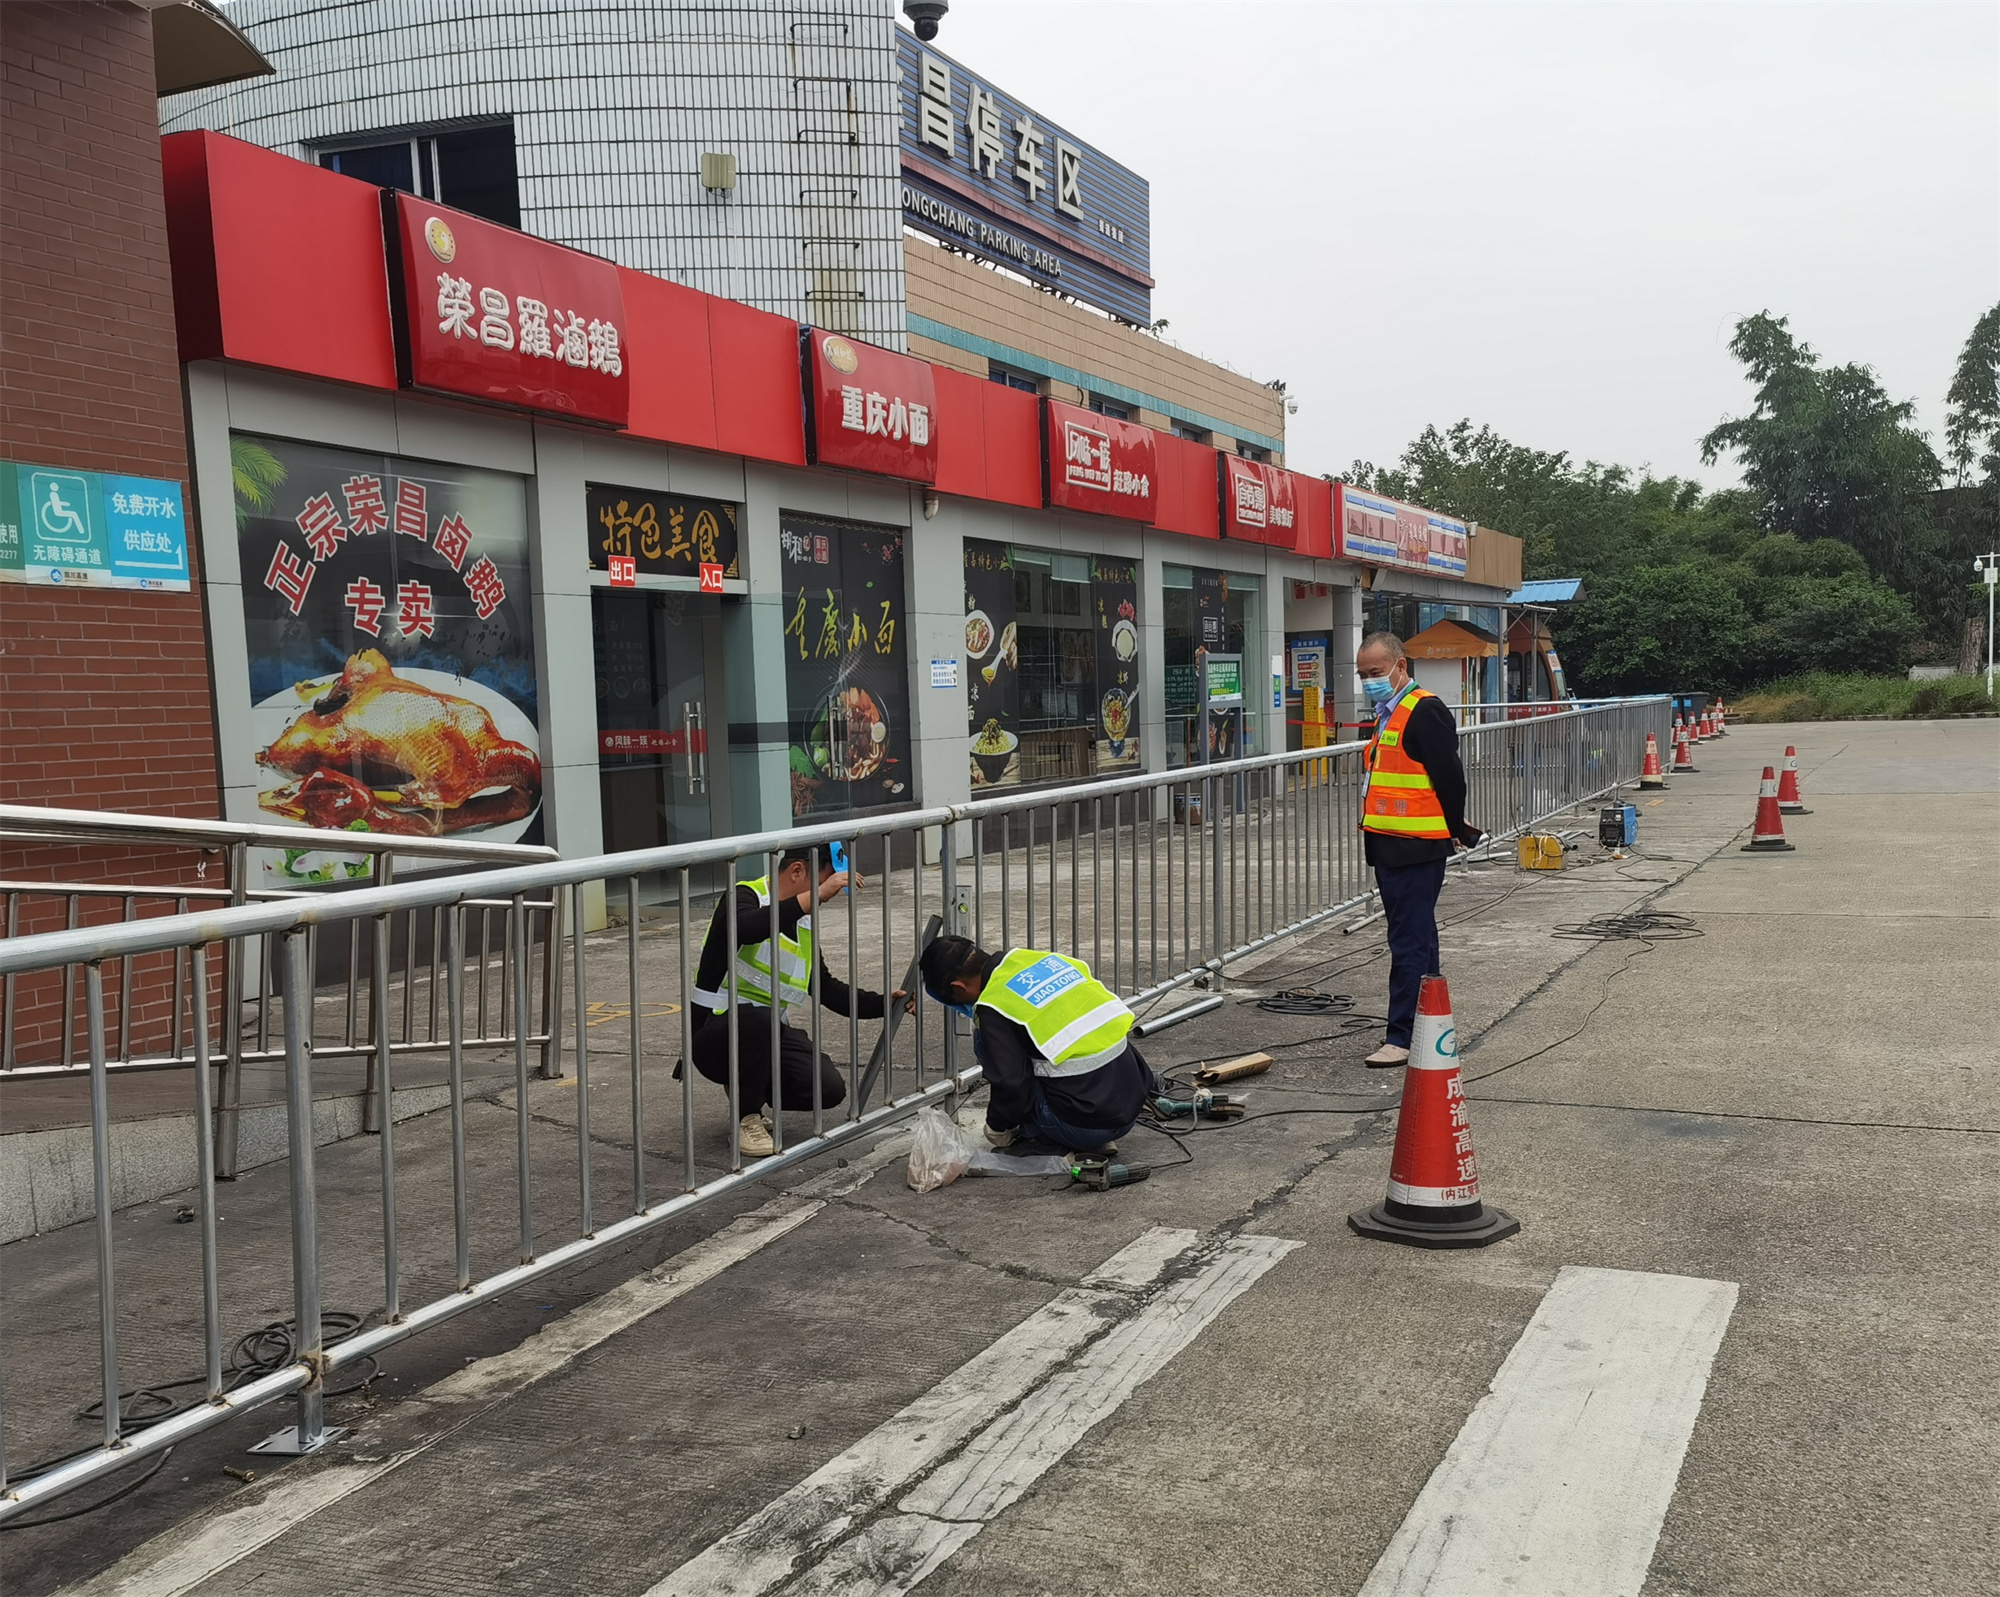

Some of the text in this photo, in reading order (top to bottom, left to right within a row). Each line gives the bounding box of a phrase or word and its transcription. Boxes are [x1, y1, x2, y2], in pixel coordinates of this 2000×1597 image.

[897, 43, 1084, 221] 昌停车区
[980, 224, 1029, 262] PARKING
[1034, 250, 1062, 277] AREA
[840, 385, 930, 447] 重庆小面
[111, 492, 177, 519] 免费开水
[123, 529, 173, 554] 供应处
[263, 474, 507, 621] 正宗荣昌卤鹅
[599, 499, 720, 564] 特色美食
[33, 544, 103, 565] 无障碍通道
[610, 559, 635, 583] 出口
[701, 567, 723, 589] 入口
[344, 576, 437, 639] 专卖
[1016, 957, 1066, 990] 交通
[1033, 971, 1080, 1003] JIAO TONG
